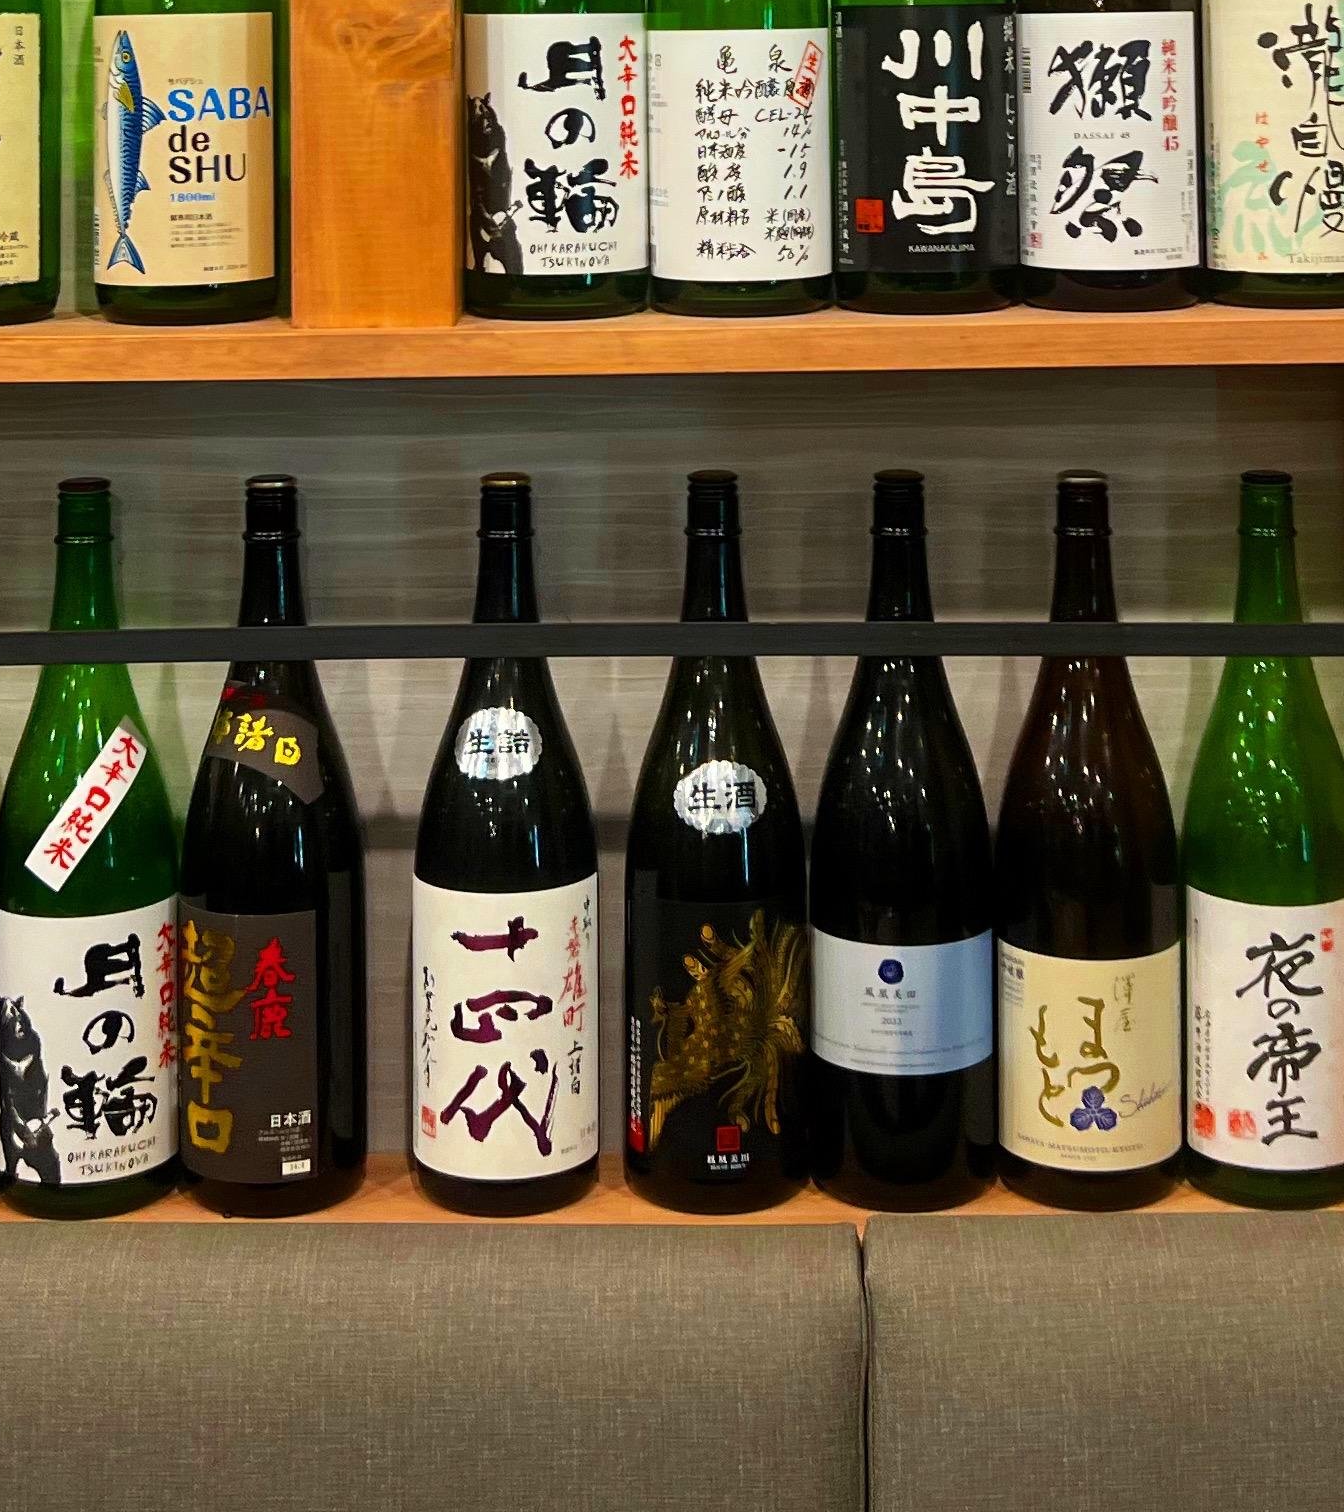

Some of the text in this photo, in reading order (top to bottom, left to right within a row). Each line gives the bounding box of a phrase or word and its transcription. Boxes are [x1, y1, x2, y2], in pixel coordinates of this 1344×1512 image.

[13, 24, 26, 68] 日本酒
[167, 85, 271, 123] SABA
[616, 34, 642, 181] 大辛口純米
[1160, 39, 1180, 151] 純米大吟醸45
[168, 124, 211, 153] de
[518, 34, 620, 235] 月の輪
[881, 19, 997, 236] 川中島
[1047, 39, 1160, 243] 獺祭
[168, 152, 247, 185] SHU
[776, 142, 812, 159] -15
[783, 161, 808, 179] 1.9
[169, 192, 217, 203] 1800ml
[783, 183, 808, 200] 1.1
[776, 244, 811, 267] 50%
[463, 728, 531, 756] 生詰
[44, 736, 140, 870] 大辛口純米
[687, 781, 757, 813] 生酒
[156, 921, 178, 1069] 大辛口純米
[247, 937, 297, 1040] 春鹿
[52, 932, 158, 1140] 月の輪
[439, 915, 554, 1157] 十四代
[1236, 931, 1324, 1147] 夜の帝王
[270, 1109, 312, 1129] 日本酒
